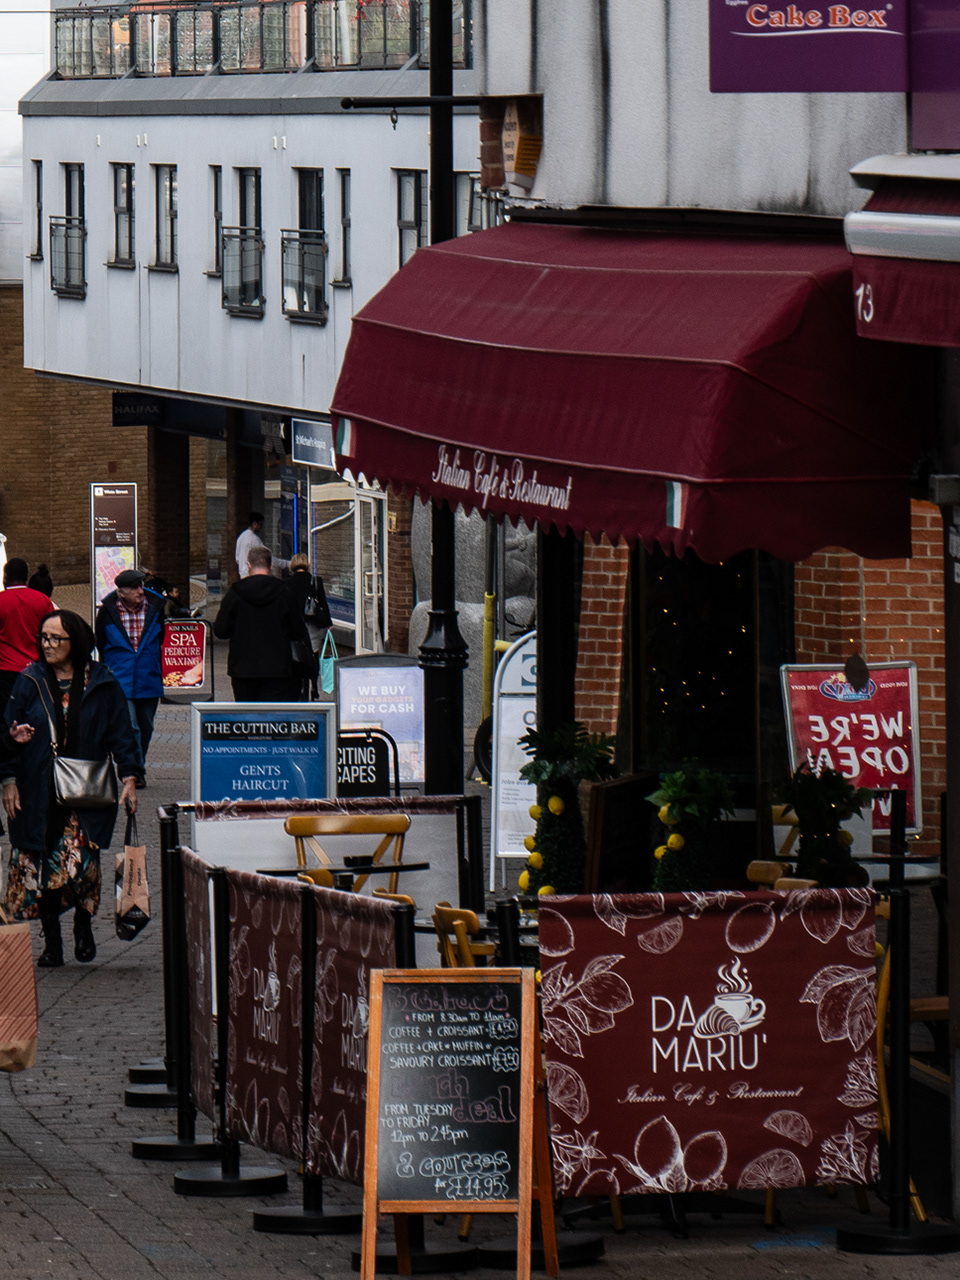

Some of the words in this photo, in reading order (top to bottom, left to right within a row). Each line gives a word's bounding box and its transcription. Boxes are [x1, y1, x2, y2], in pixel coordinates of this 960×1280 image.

[746, 3, 823, 28] Cake
[828, 3, 888, 28] Box
[855, 282, 874, 323] 13
[432, 444, 471, 490] Italian
[509, 458, 573, 510] Restaurant
[170, 633, 197, 646] SPA
[164, 647, 201, 656] PEDICURE
[164, 657, 200, 666] WAXING
[358, 686, 377, 696] WE
[381, 686, 406, 695] BUY
[350, 704, 376, 713] FOR
[378, 703, 414, 713] CASH
[205, 723, 230, 734] THE
[232, 723, 288, 734] CUTTING
[290, 723, 316, 734] BAR
[337, 747, 376, 765] ITING
[240, 765, 281, 776] GENTS
[337, 766, 376, 783] APES
[232, 780, 289, 791] HAIRCUT
[412, 1013, 435, 1022] FROM
[469, 1012, 480, 1020] TO
[651, 995, 697, 1032] DA
[388, 1026, 421, 1038] COFFEE
[437, 1025, 484, 1036] CROISSANT
[382, 1042, 415, 1054] COFFEE
[453, 1041, 484, 1051] MUFFIN
[390, 1054, 434, 1069] SAVOURY
[437, 1054, 492, 1067] CROISSANT
[617, 1084, 668, 1104] Italian
[726, 1081, 804, 1099] Restaurant
[384, 1104, 409, 1115] FROM
[413, 1103, 454, 1116] TUESDAY
[381, 1117, 395, 1128] TO
[396, 1114, 431, 1128] FRIDAY
